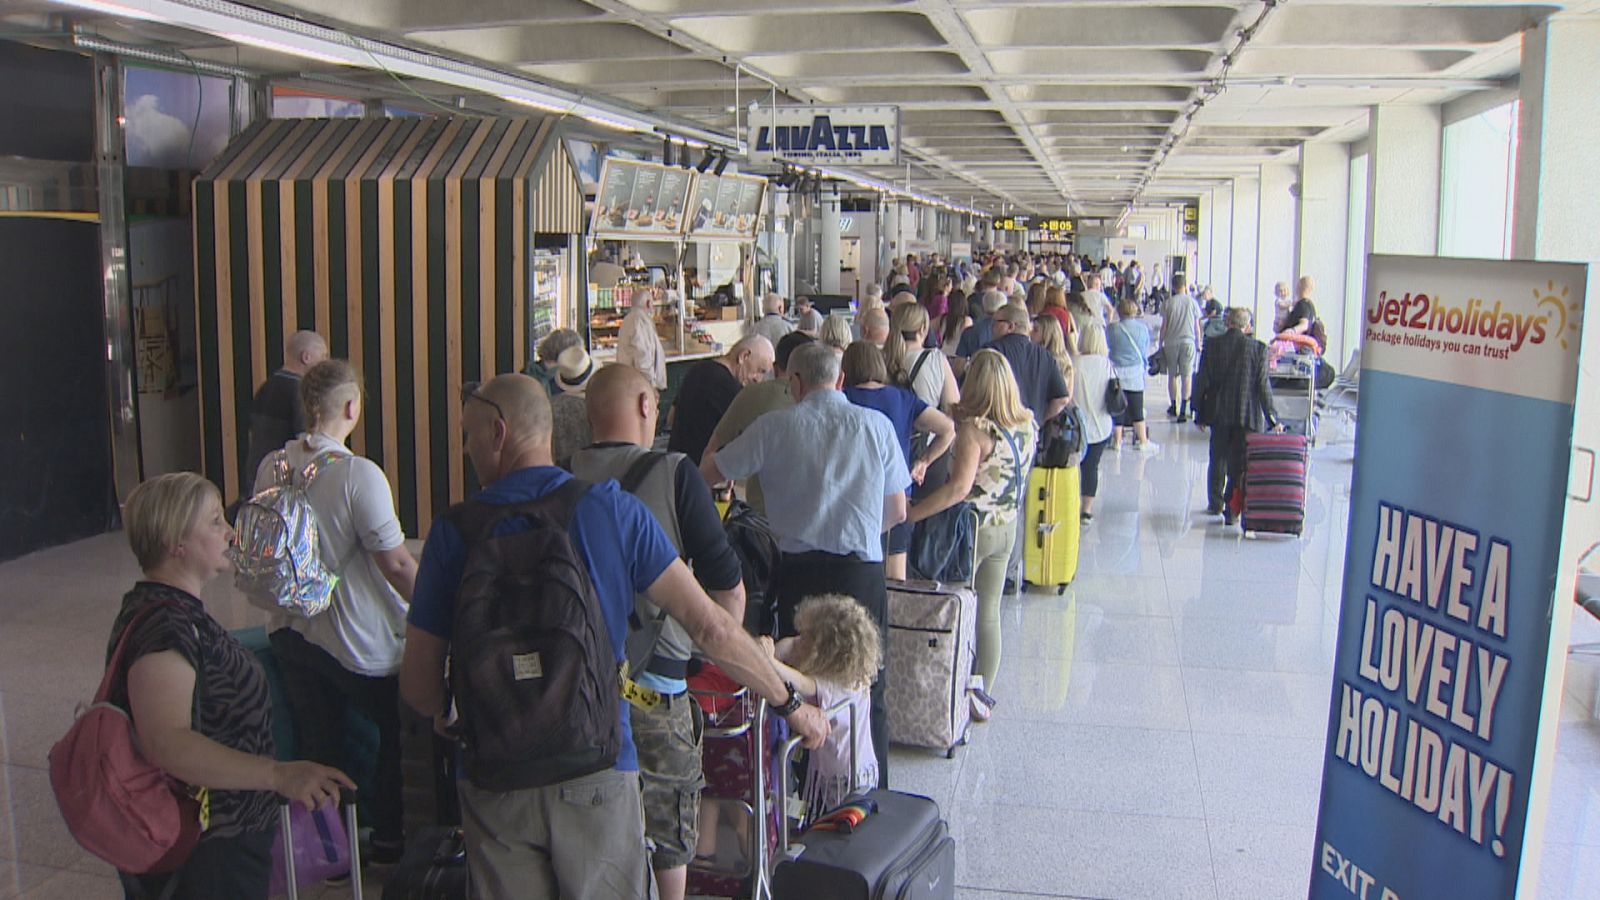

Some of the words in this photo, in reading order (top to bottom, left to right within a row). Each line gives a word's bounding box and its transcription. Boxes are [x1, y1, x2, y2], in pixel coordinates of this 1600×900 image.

[756, 116, 890, 151] LAVAZZA
[1060, 220, 1072, 230] 05
[1366, 328, 1401, 346] Package
[1403, 331, 1441, 350] holidays
[1443, 341, 1460, 353] you
[1463, 343, 1481, 356] can
[1483, 344, 1509, 360] trust
[1367, 290, 1549, 352] Jet2holidays
[1371, 504, 1478, 623] HAVE
[1477, 540, 1509, 638] A
[1359, 597, 1510, 742] LOVELY
[1335, 682, 1514, 858] HOLIDAY!
[1321, 840, 1376, 900] EXIT
